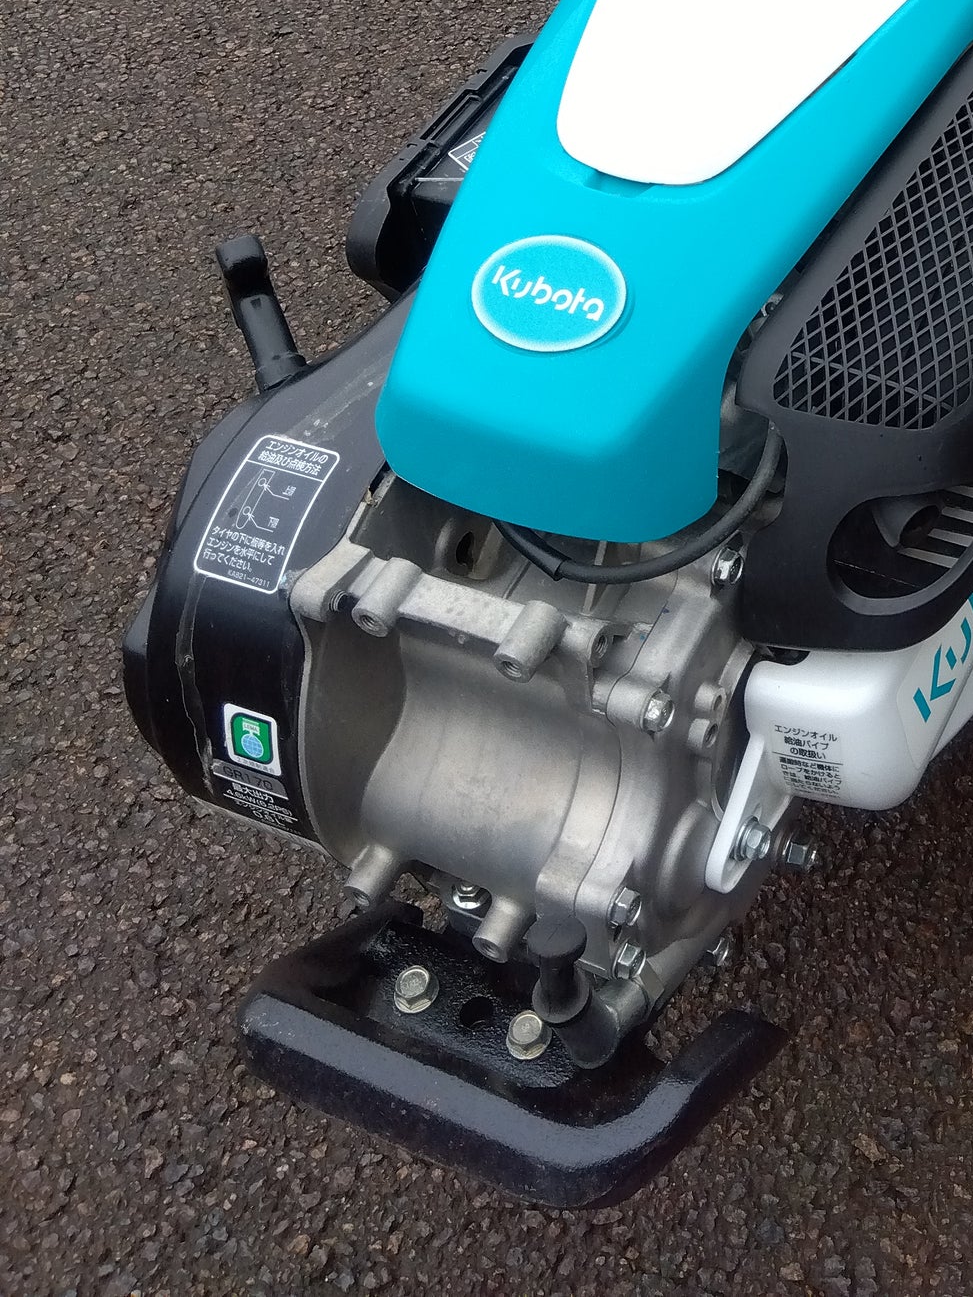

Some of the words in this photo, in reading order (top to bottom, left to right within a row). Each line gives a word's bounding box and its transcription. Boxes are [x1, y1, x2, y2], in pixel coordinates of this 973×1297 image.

[492, 265, 605, 321] Kubota
[257, 450, 322, 476] 給油及び点検方法
[265, 440, 329, 464] エンジンオイルの
[206, 537, 275, 566] エンジンを水平にして
[774, 725, 838, 742] エンジンオイル
[784, 736, 829, 751] 給油パイプ
[789, 747, 827, 760] の取扱い
